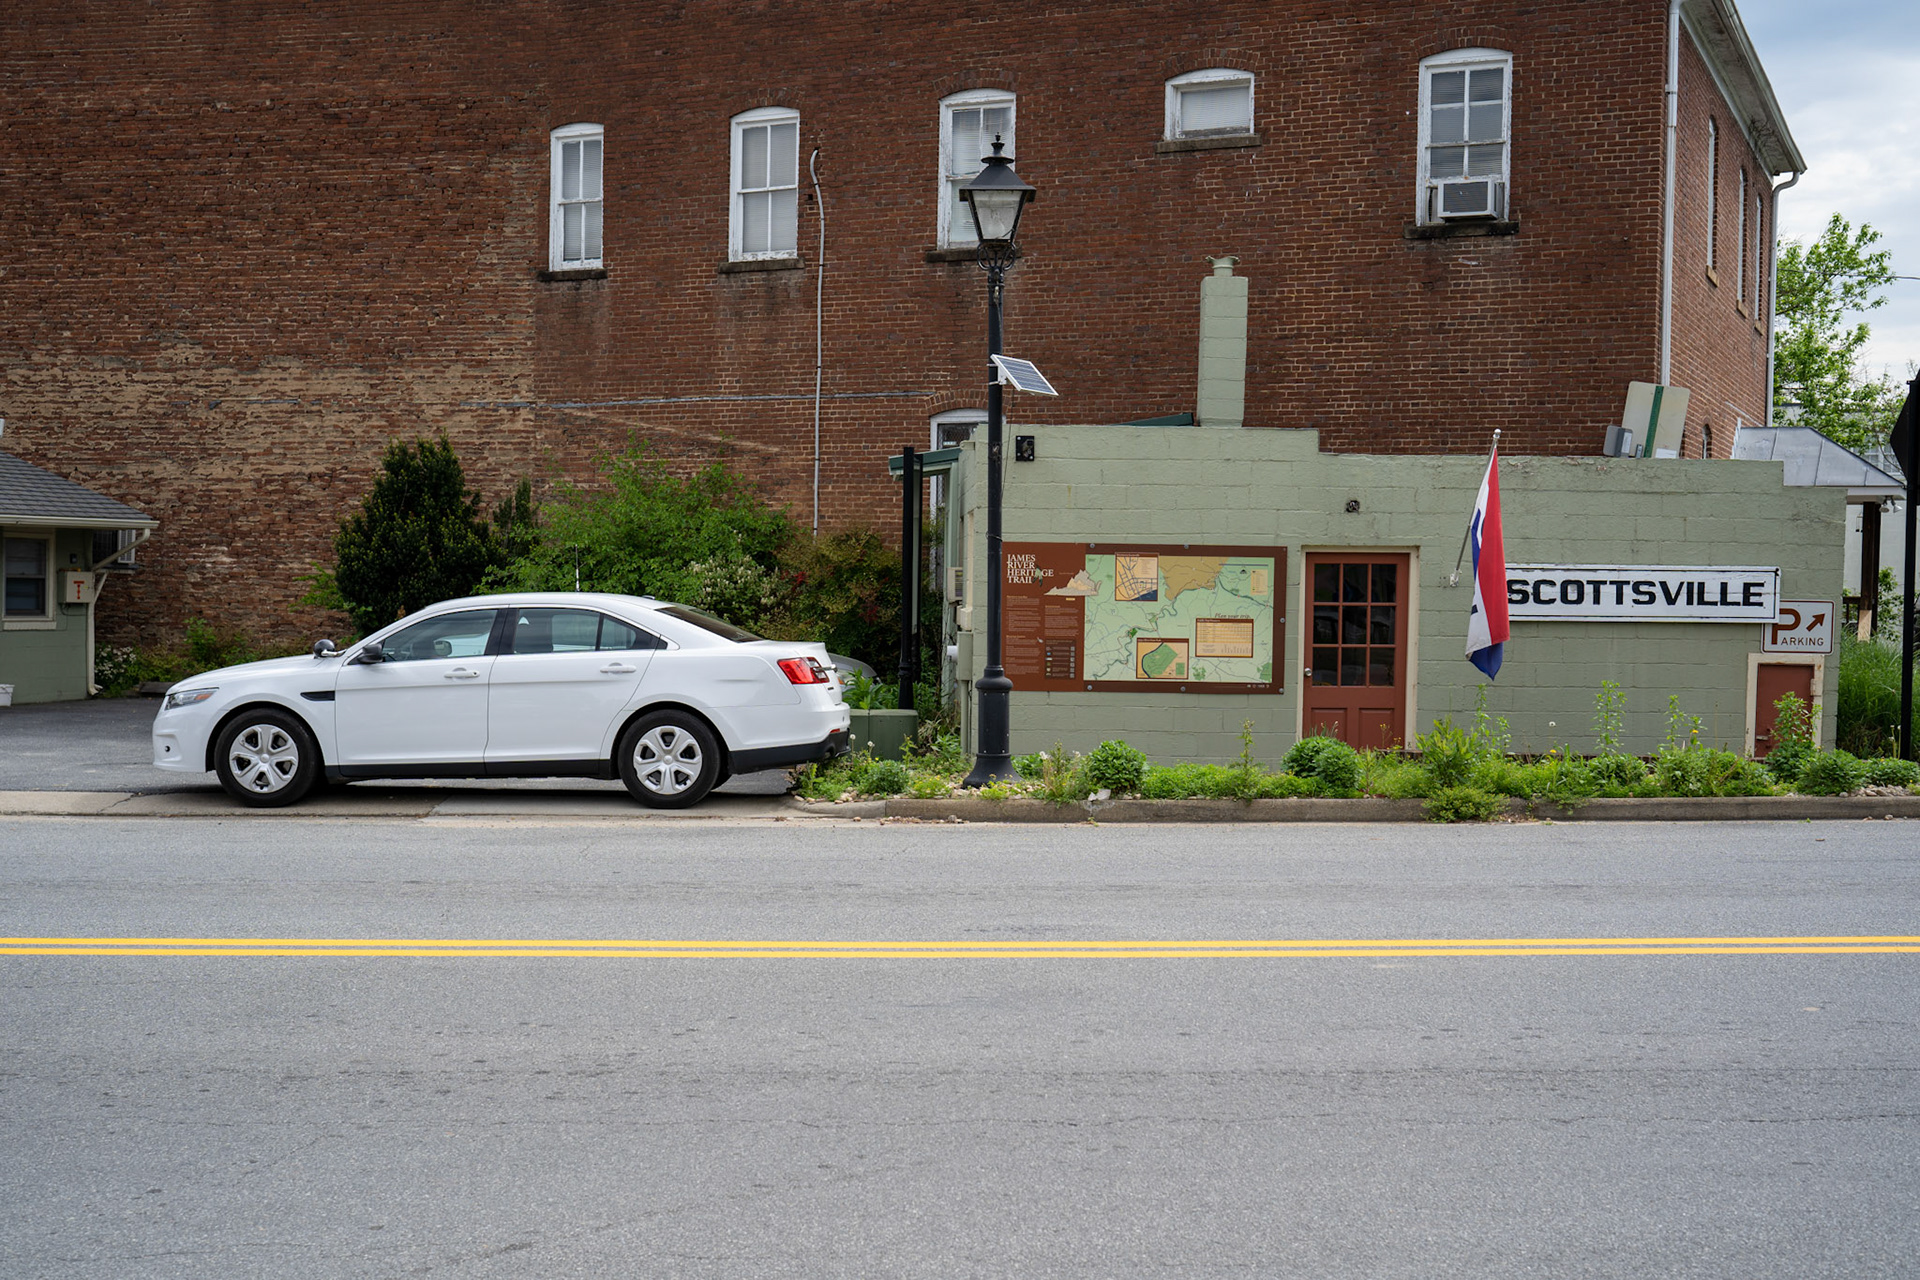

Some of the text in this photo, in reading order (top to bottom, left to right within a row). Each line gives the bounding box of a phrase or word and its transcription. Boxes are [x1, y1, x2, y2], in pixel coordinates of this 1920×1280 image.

[1007, 554, 1035, 562] JAMES
[1008, 576, 1033, 584] TRAIL
[1507, 579, 1765, 607] SCOTTSVILLE
